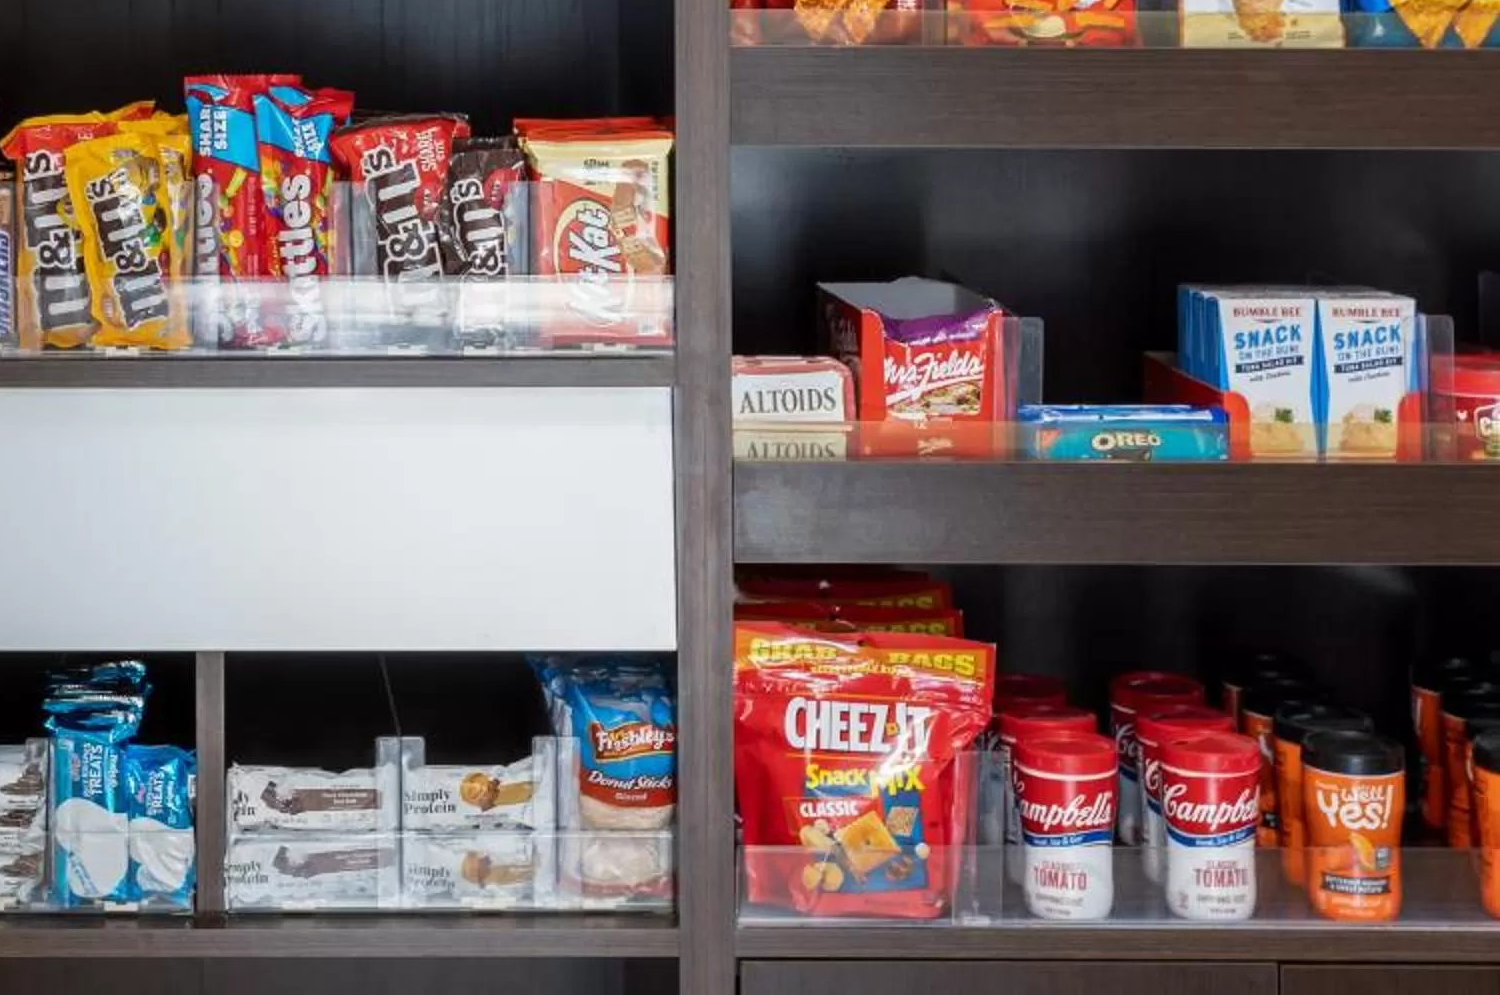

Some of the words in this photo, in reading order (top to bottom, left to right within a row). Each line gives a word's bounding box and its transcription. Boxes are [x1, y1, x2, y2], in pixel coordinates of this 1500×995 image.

[1234, 324, 1303, 350] SNACK
[1333, 324, 1401, 350] SNACK
[914, 349, 985, 399] Fields
[739, 387, 839, 414] ALTOIDS
[1091, 431, 1161, 452] OREO
[888, 652, 977, 677] BAGS
[89, 744, 104, 795] TREATS
[587, 770, 635, 790] Donut
[635, 774, 673, 790] Sticks
[805, 764, 869, 790] Snack
[799, 800, 859, 818] CLASSIC
[1163, 782, 1261, 832] Campbe
[1315, 783, 1395, 831] Yes!
[1034, 867, 1089, 892] TOMATO
